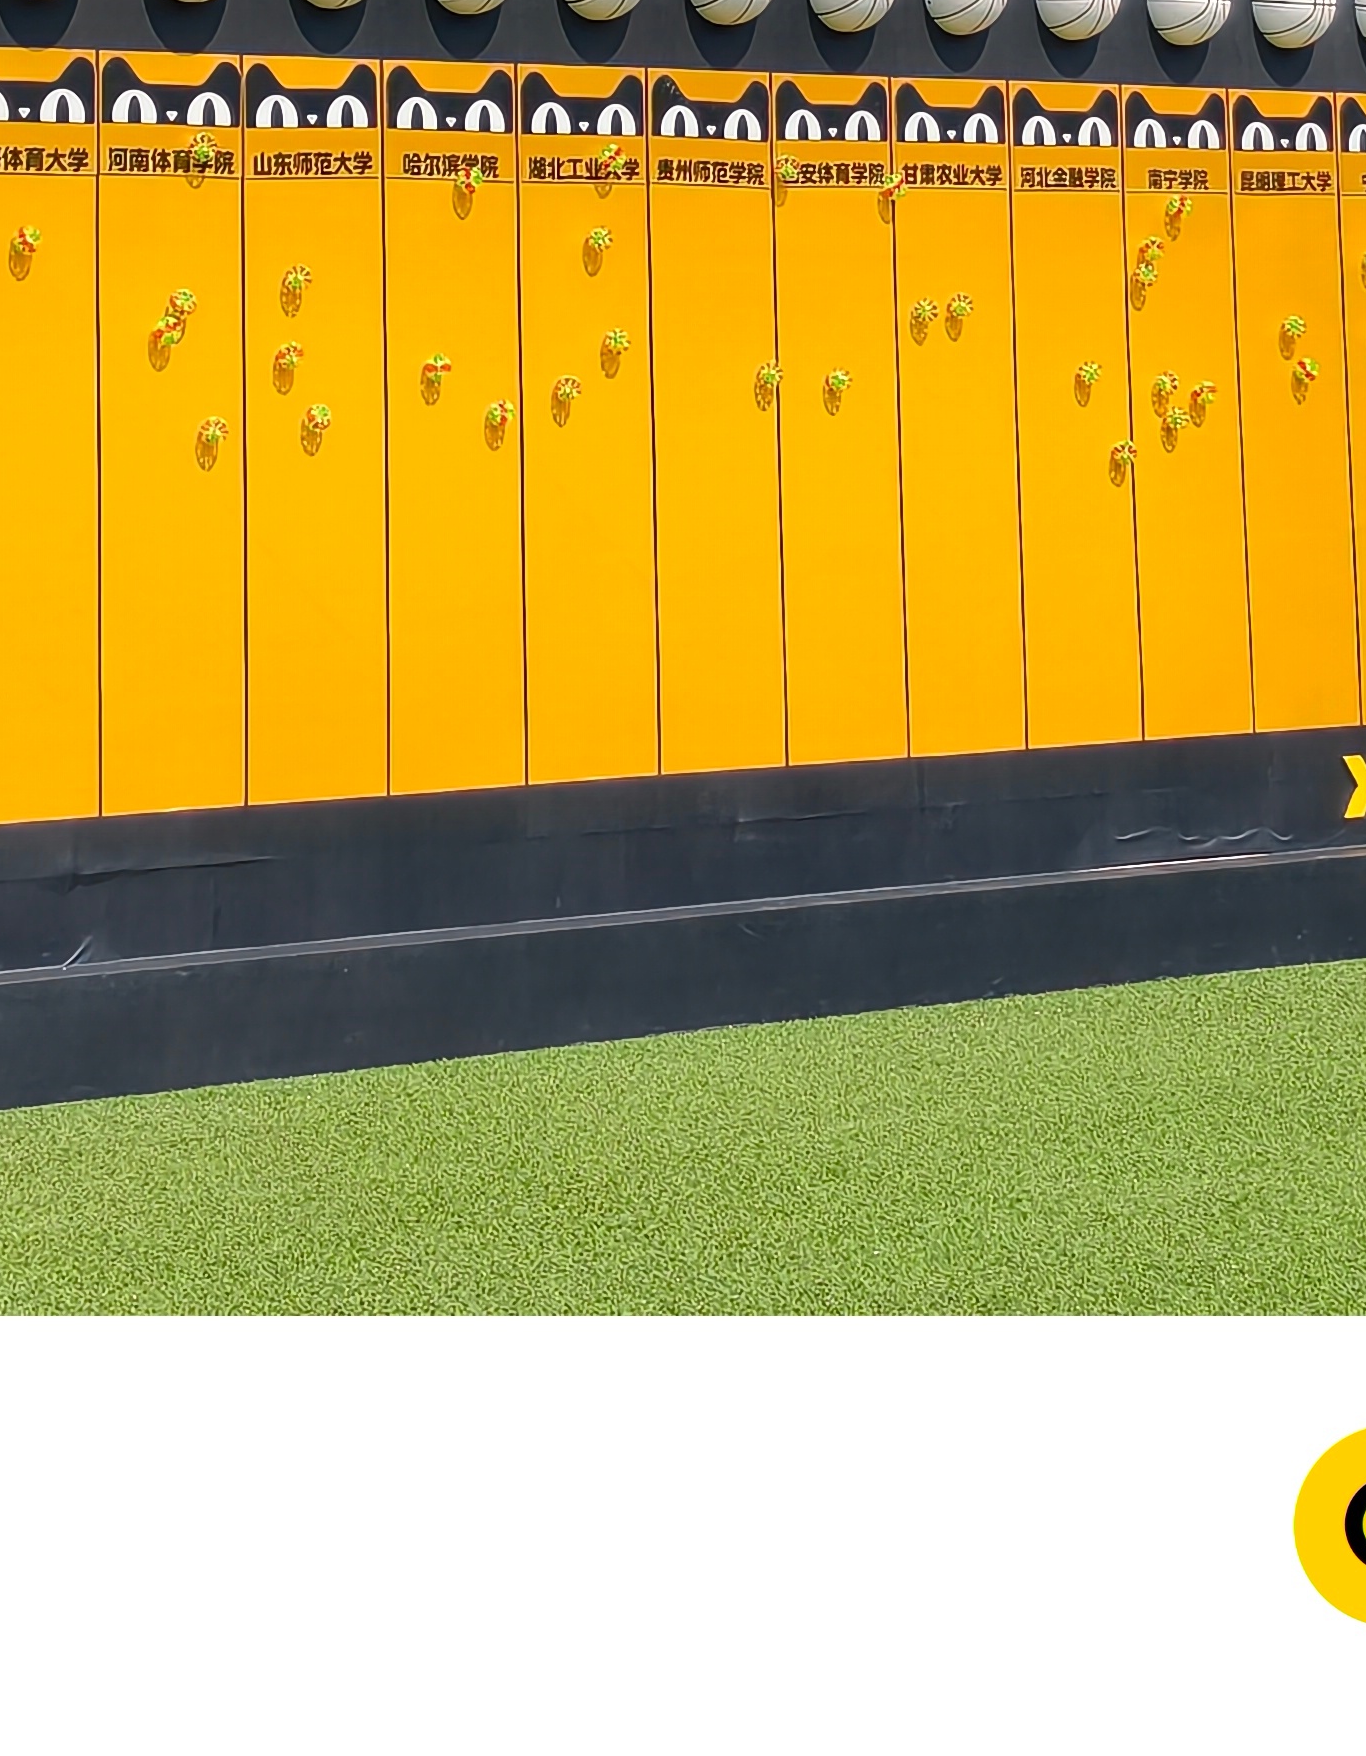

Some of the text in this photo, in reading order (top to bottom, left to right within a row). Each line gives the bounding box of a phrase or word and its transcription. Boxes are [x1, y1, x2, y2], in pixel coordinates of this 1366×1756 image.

[252, 149, 374, 177] 山东师范大学
[656, 158, 766, 186] 贵州师范学院
[781, 162, 886, 185] 安体育学院
[901, 162, 1003, 187] 甘肃农业大学
[1019, 166, 1117, 189] 河北金融学院
[1147, 168, 1210, 191] 南宁学院
